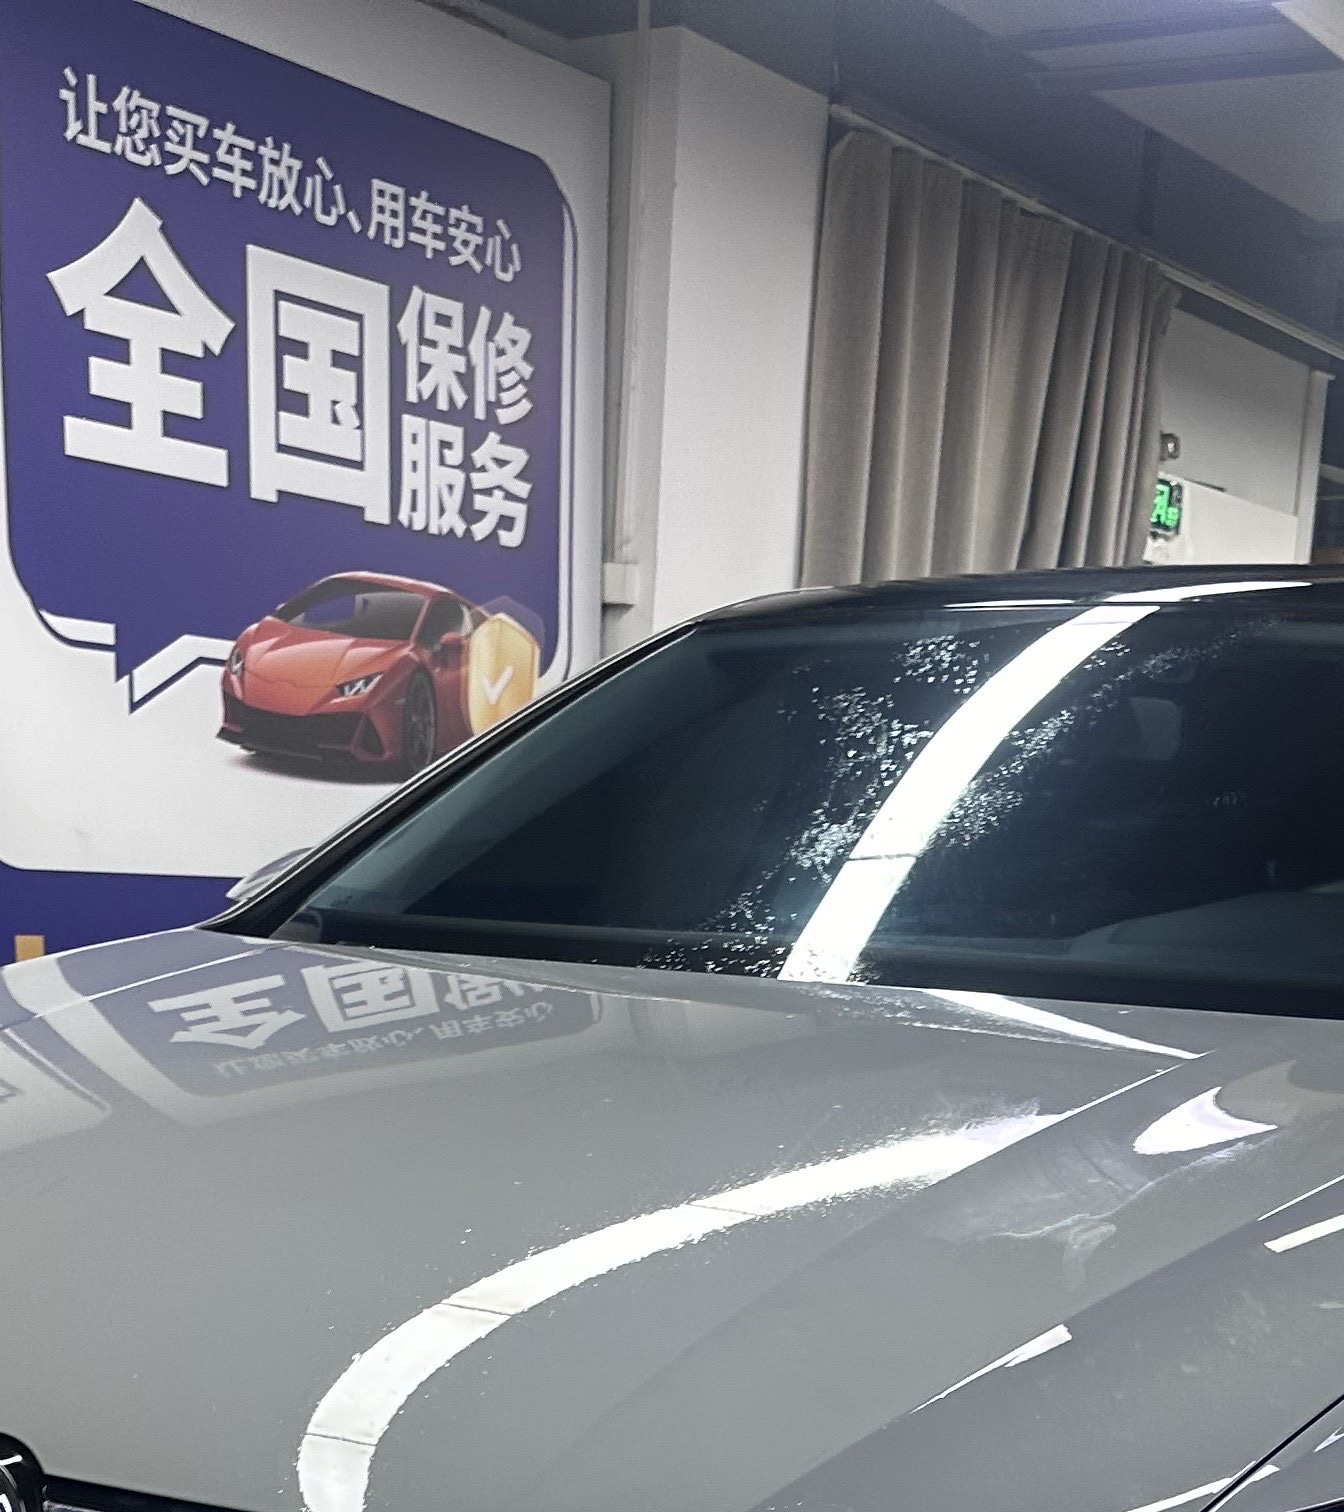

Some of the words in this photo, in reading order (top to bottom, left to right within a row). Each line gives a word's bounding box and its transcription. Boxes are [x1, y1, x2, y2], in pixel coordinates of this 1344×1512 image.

[59, 66, 522, 284] 让您买车放心、用车安心
[47, 197, 393, 525] 全国
[396, 284, 536, 427] 保修
[397, 413, 534, 550] 服务
